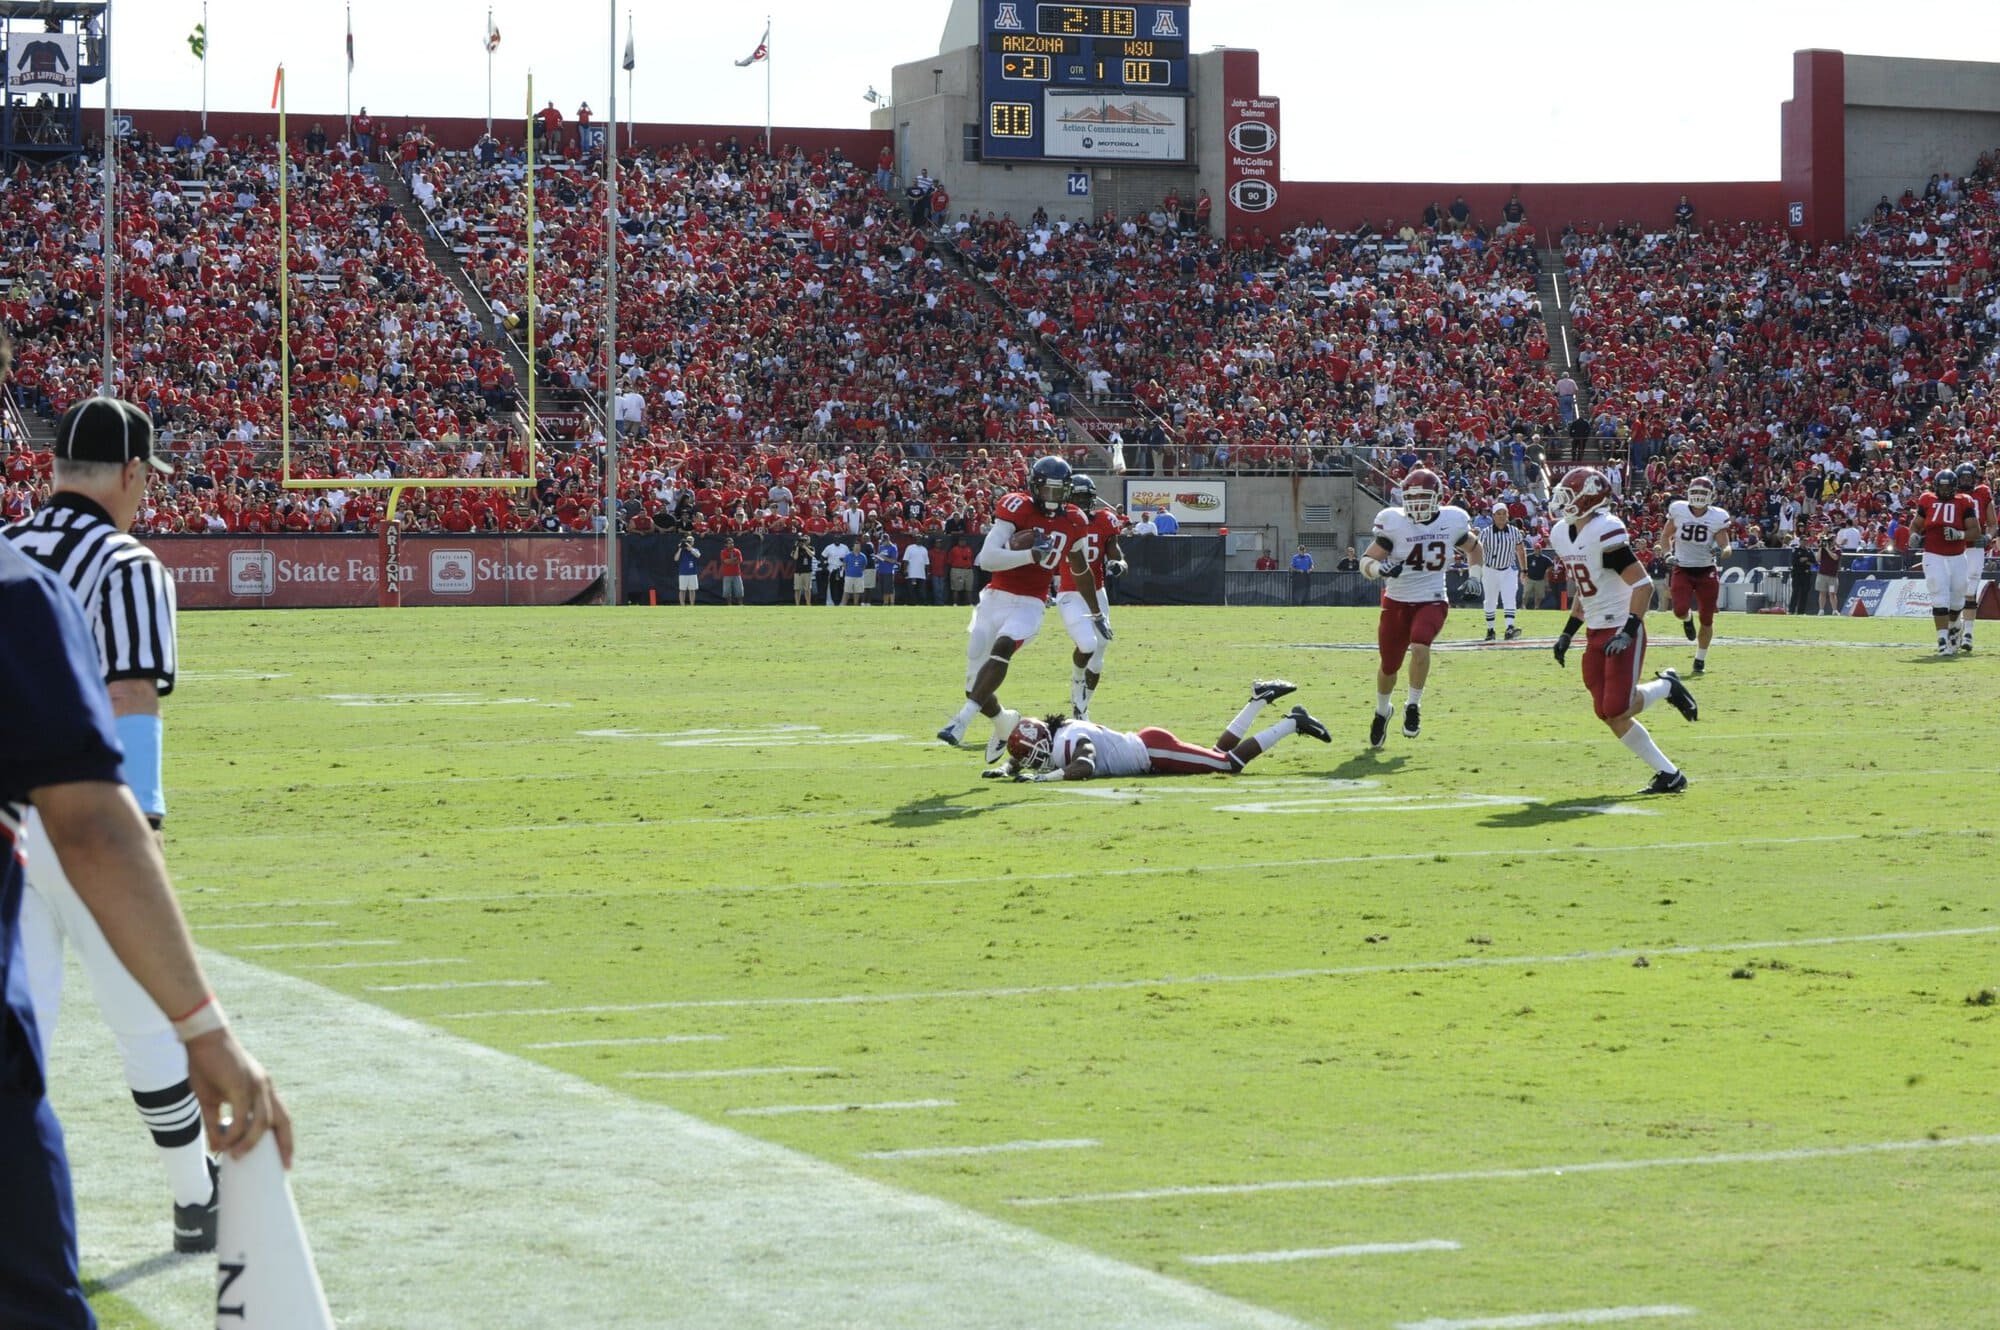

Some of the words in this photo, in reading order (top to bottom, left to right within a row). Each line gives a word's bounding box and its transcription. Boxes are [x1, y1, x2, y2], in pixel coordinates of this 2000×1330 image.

[1063, 8, 1133, 34] 2:18
[1002, 35, 1064, 53] ARIZONA
[1124, 41, 1153, 56] WSU
[1069, 65, 1084, 75] QTR
[1098, 62, 1104, 79] 1
[1124, 62, 1150, 82] 00
[1231, 99, 1247, 107] John
[1249, 100, 1278, 109] "Button"
[992, 105, 1029, 135] 00
[1240, 109, 1265, 117] Salmon
[112, 119, 131, 136] 12
[1062, 124, 1086, 132] Action
[588, 131, 604, 147] 13
[1233, 157, 1273, 166] McCollins
[1242, 167, 1265, 175] Umeh
[1068, 176, 1088, 193] 14
[1247, 192, 1259, 201] 90
[1789, 206, 1802, 223] 15
[537, 417, 564, 426] SECTN
[1001, 494, 1024, 513] 18
[1932, 502, 1956, 524] 70
[1681, 523, 1709, 543] 96
[387, 525, 399, 593] ARIZONA
[1405, 541, 1447, 571] 43
[278, 559, 340, 582] State
[477, 558, 538, 581] State
[544, 558, 611, 581] Farm
[1857, 586, 1882, 598] Game
